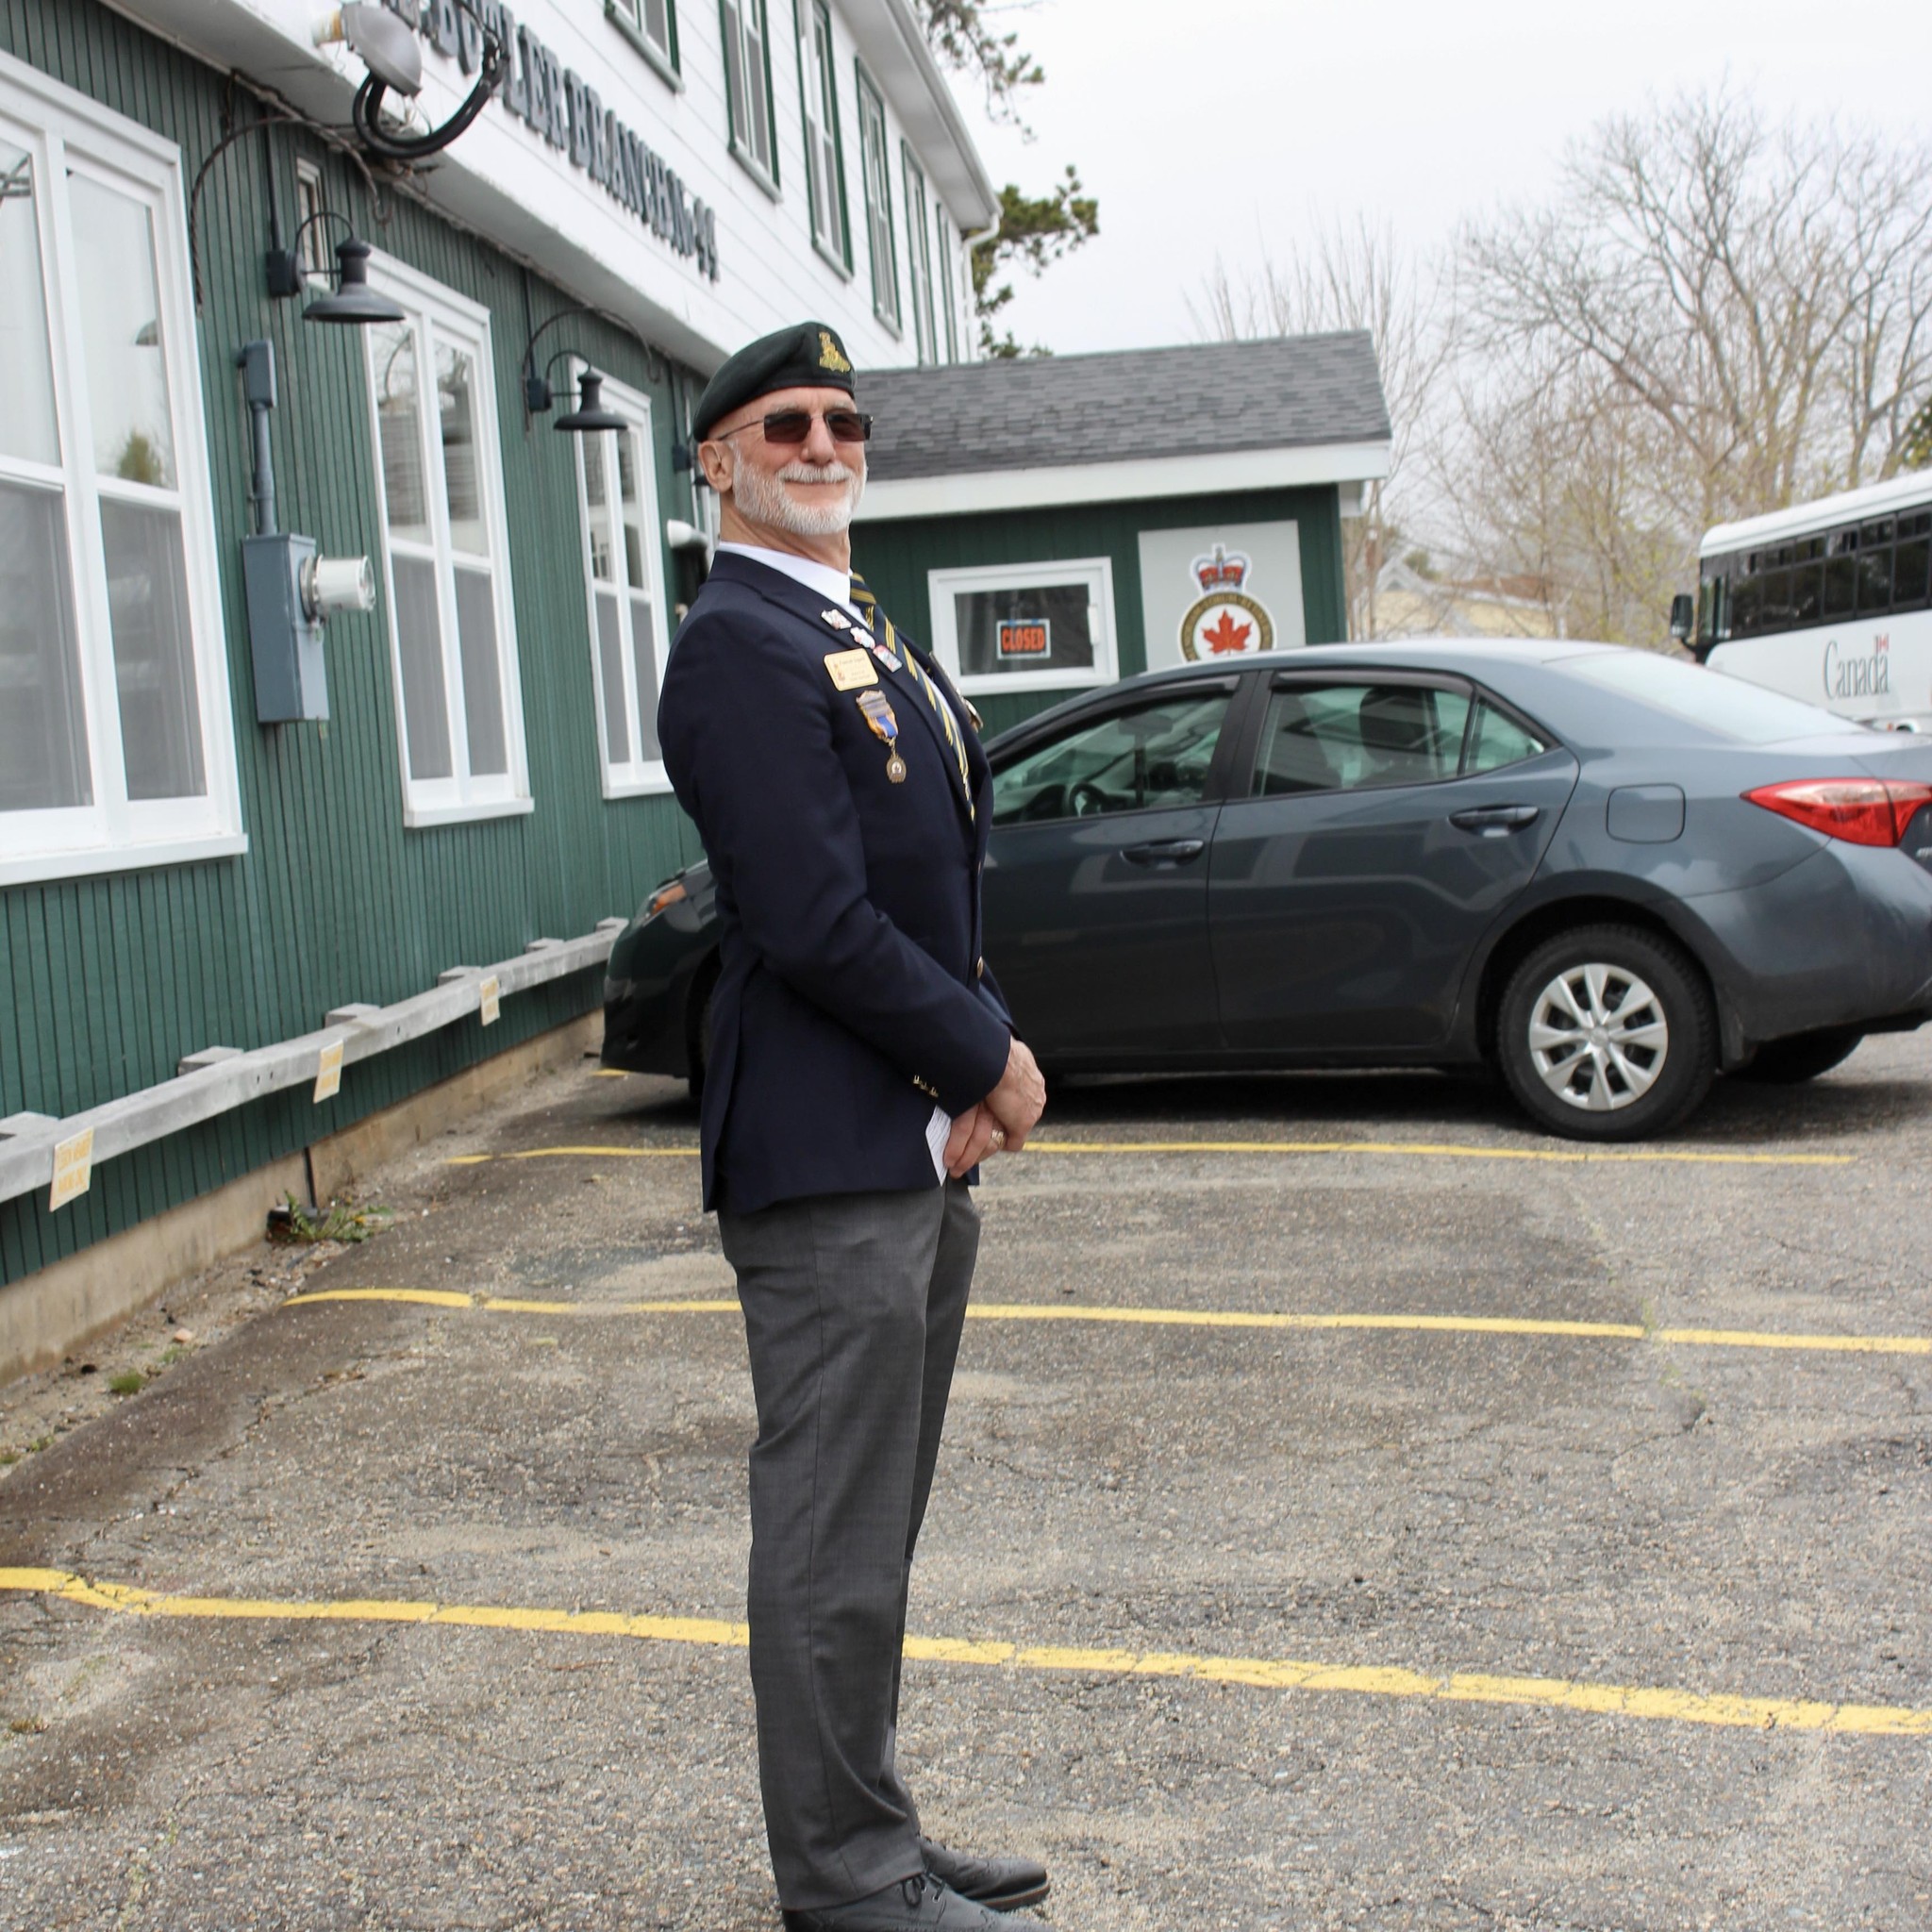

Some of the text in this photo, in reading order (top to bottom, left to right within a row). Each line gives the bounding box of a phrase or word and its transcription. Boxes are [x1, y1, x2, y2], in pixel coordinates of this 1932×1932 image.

[565, 69, 673, 240] BRANCH
[1002, 625, 1044, 652] CLOSED
[1824, 635, 1890, 700] Canada
